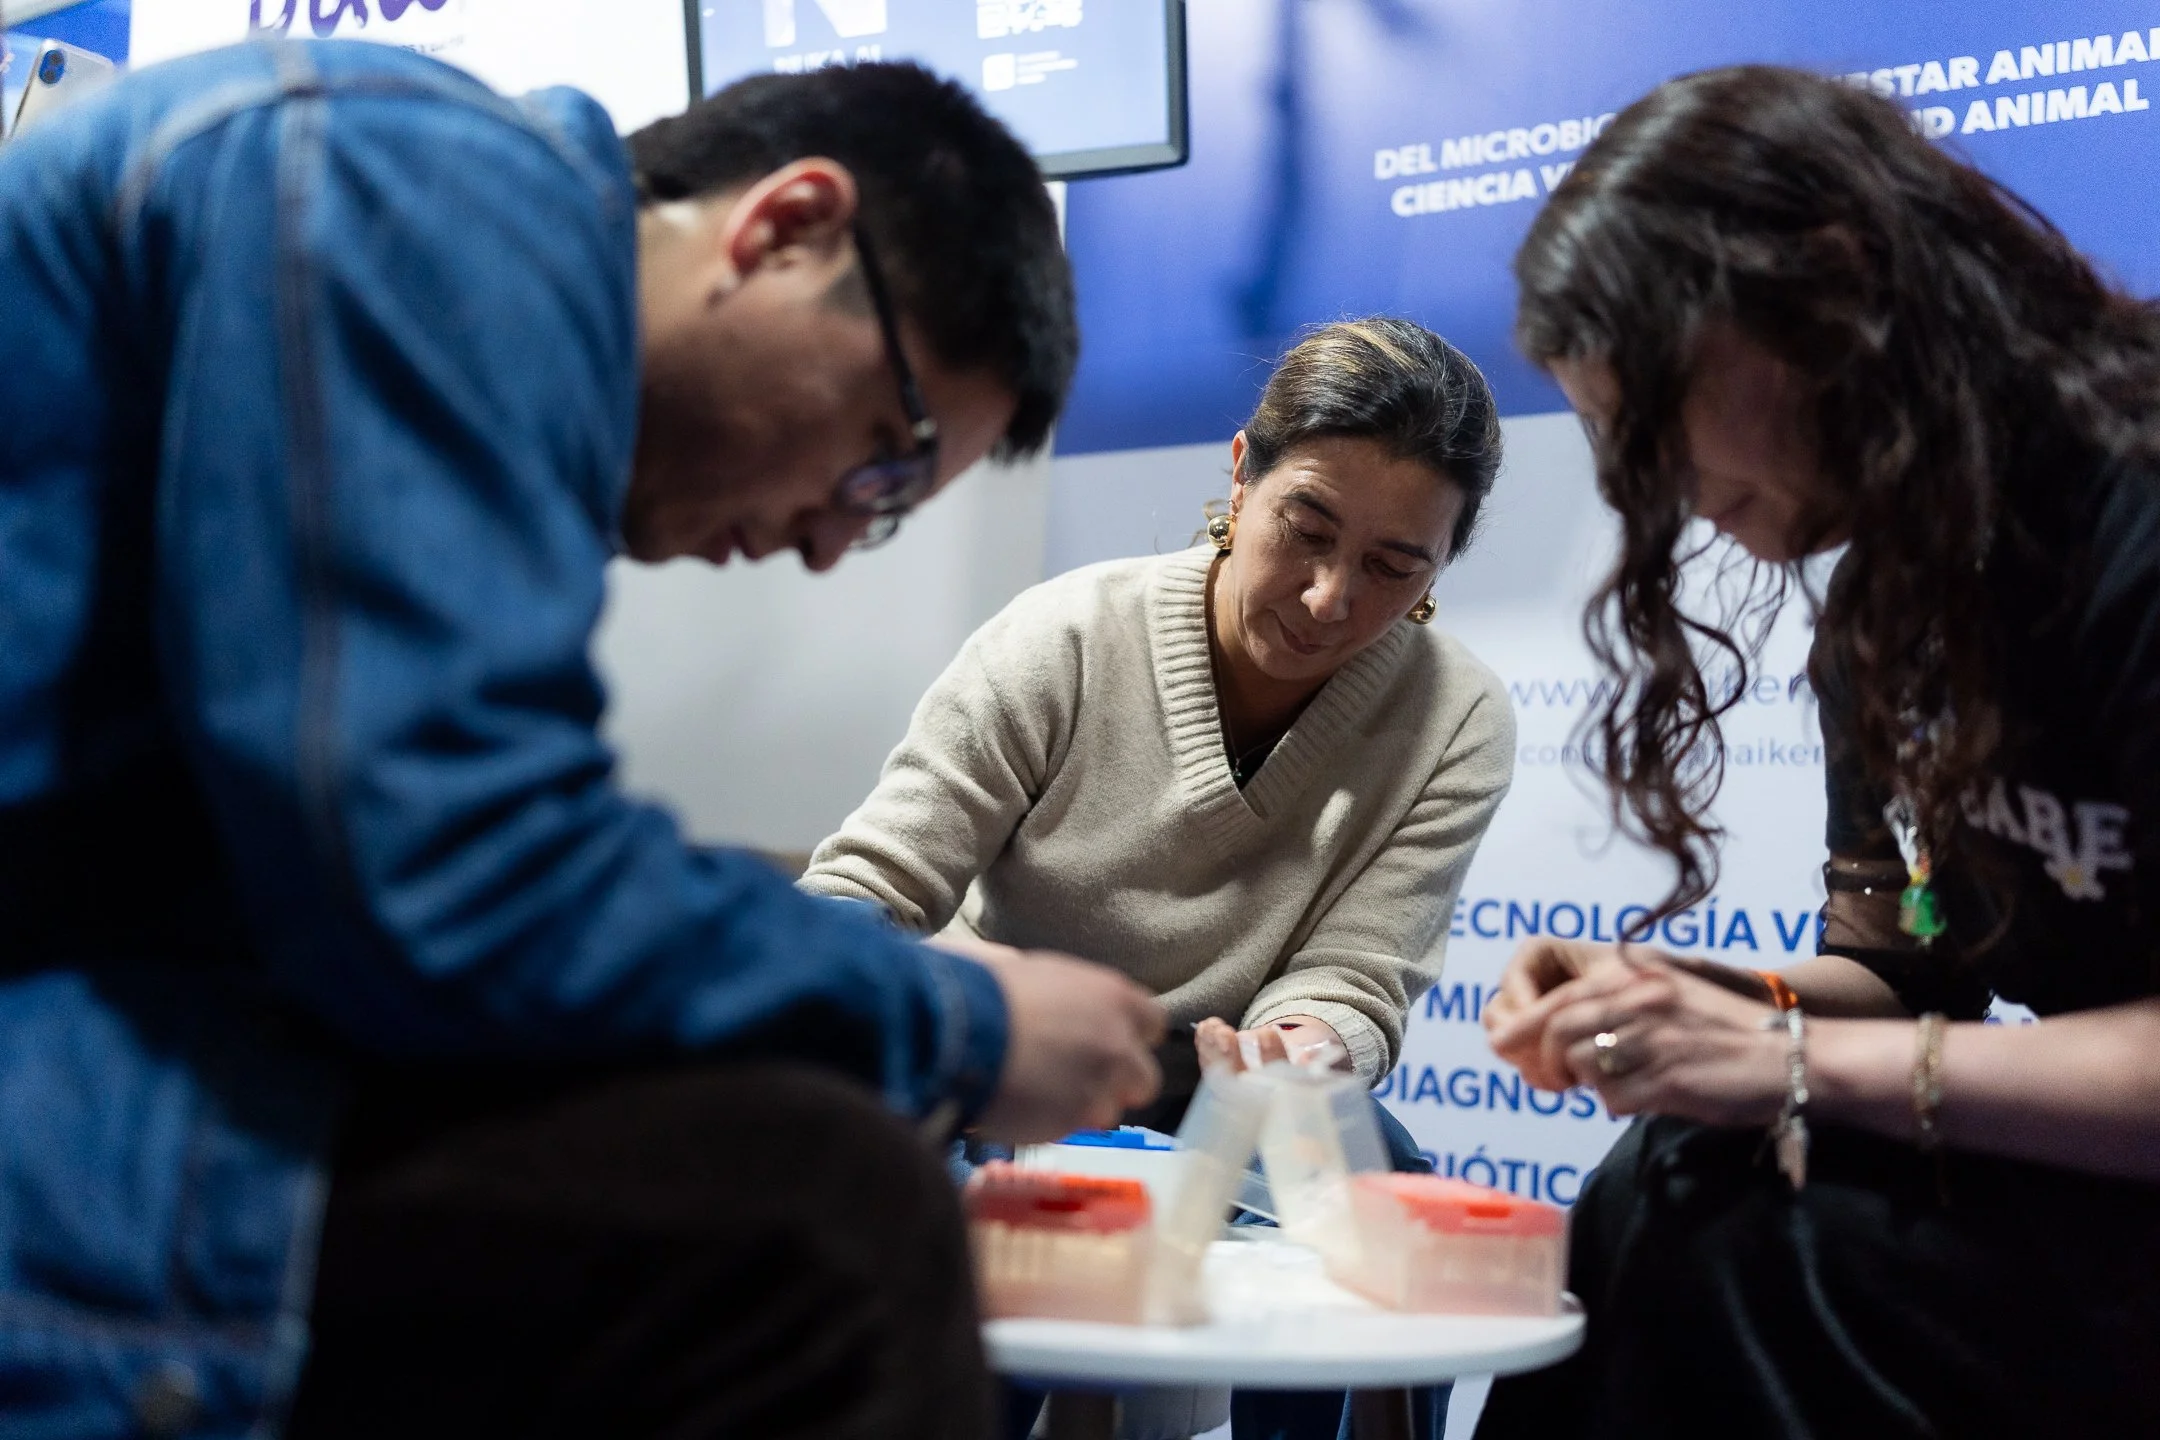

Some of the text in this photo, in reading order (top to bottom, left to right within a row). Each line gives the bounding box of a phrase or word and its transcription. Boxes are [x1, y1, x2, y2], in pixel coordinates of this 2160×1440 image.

[1374, 143, 1438, 180] DEL
[1840, 56, 1980, 97] ESTAR
[1391, 168, 1539, 217] CIENCIA
[1539, 160, 1576, 193] V
[1961, 78, 2150, 135] ANIMAL
[1448, 896, 1759, 951] ECNOLOGÍA
